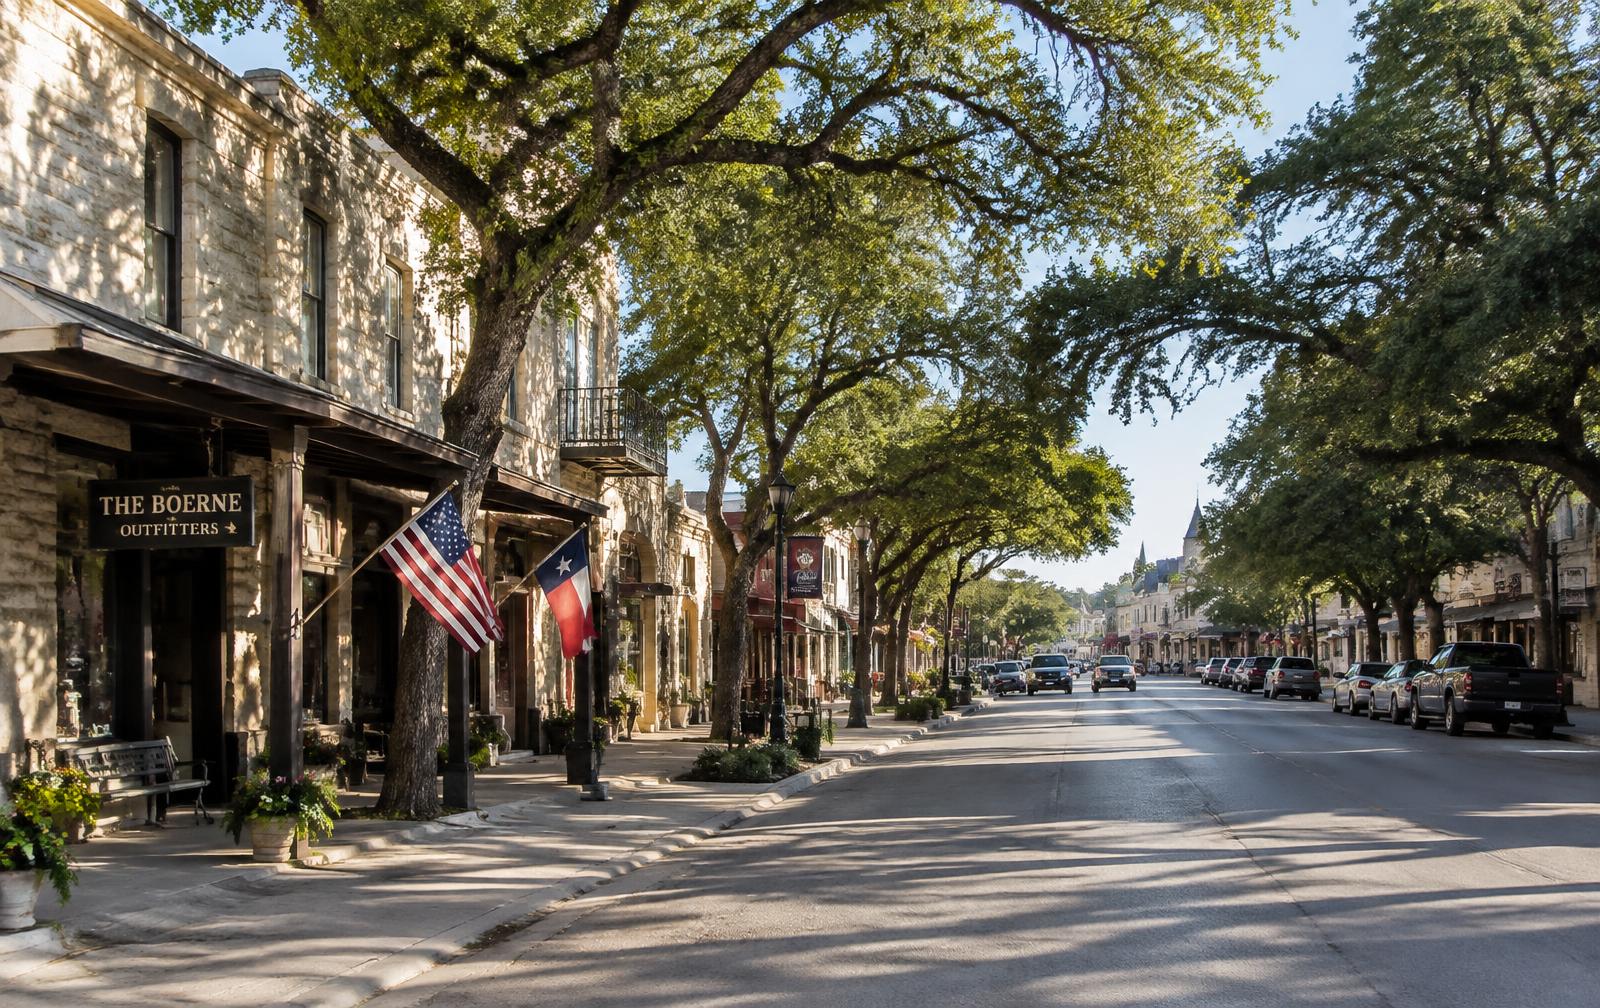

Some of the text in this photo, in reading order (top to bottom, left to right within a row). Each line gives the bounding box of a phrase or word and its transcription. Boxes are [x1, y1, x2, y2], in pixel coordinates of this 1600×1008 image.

[99, 493, 242, 515] THE BOERNE
[120, 523, 219, 536] OUTFITTERS
